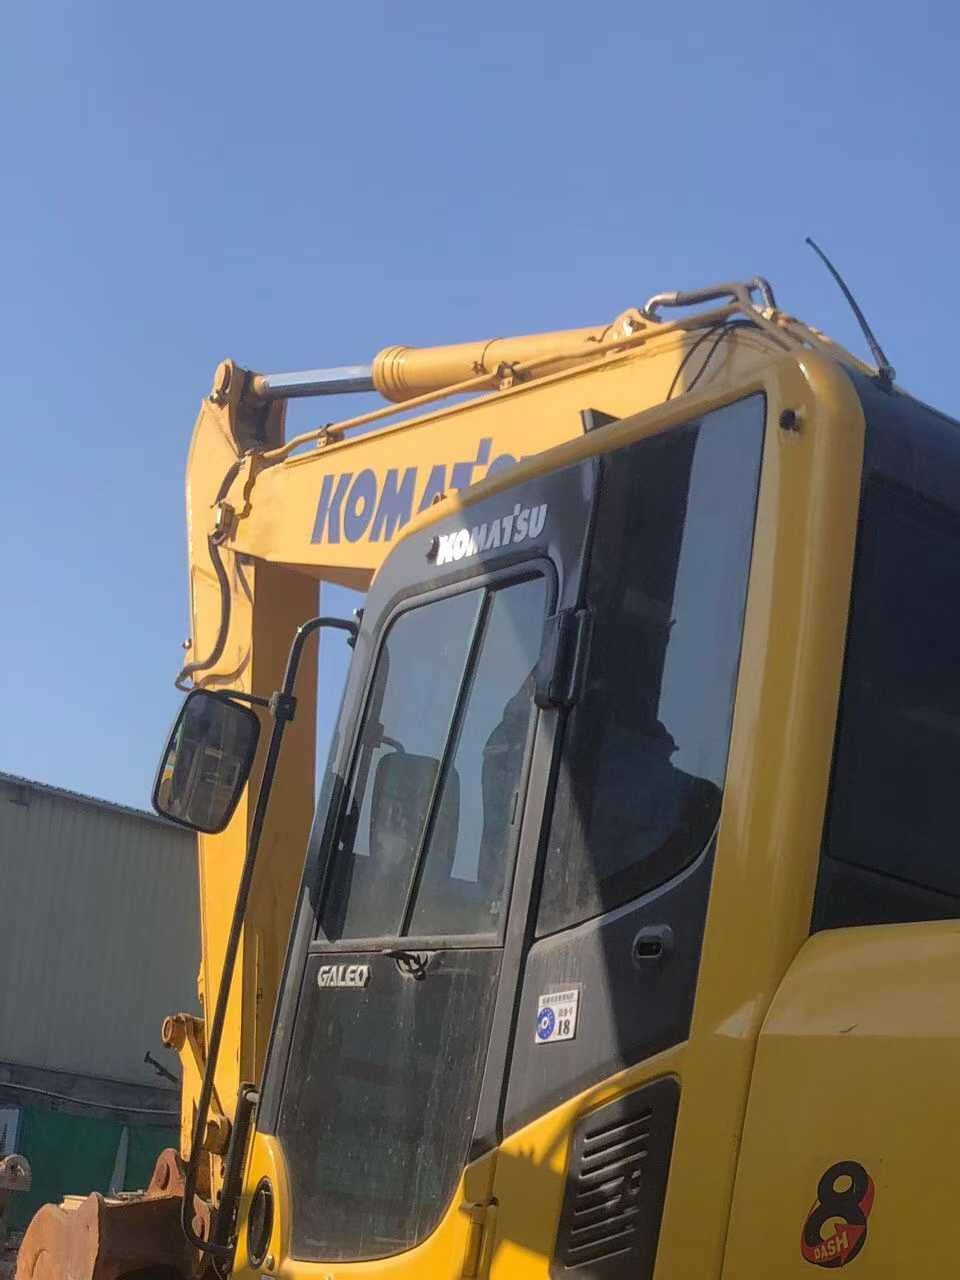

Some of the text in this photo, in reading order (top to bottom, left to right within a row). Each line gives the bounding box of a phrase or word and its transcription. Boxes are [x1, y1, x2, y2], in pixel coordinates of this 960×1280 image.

[310, 437, 523, 545] KOMAT
[436, 503, 548, 566] KOMATSU
[317, 964, 369, 988] GALEO
[557, 1018, 571, 1036] 18
[814, 1231, 849, 1260] DASH
